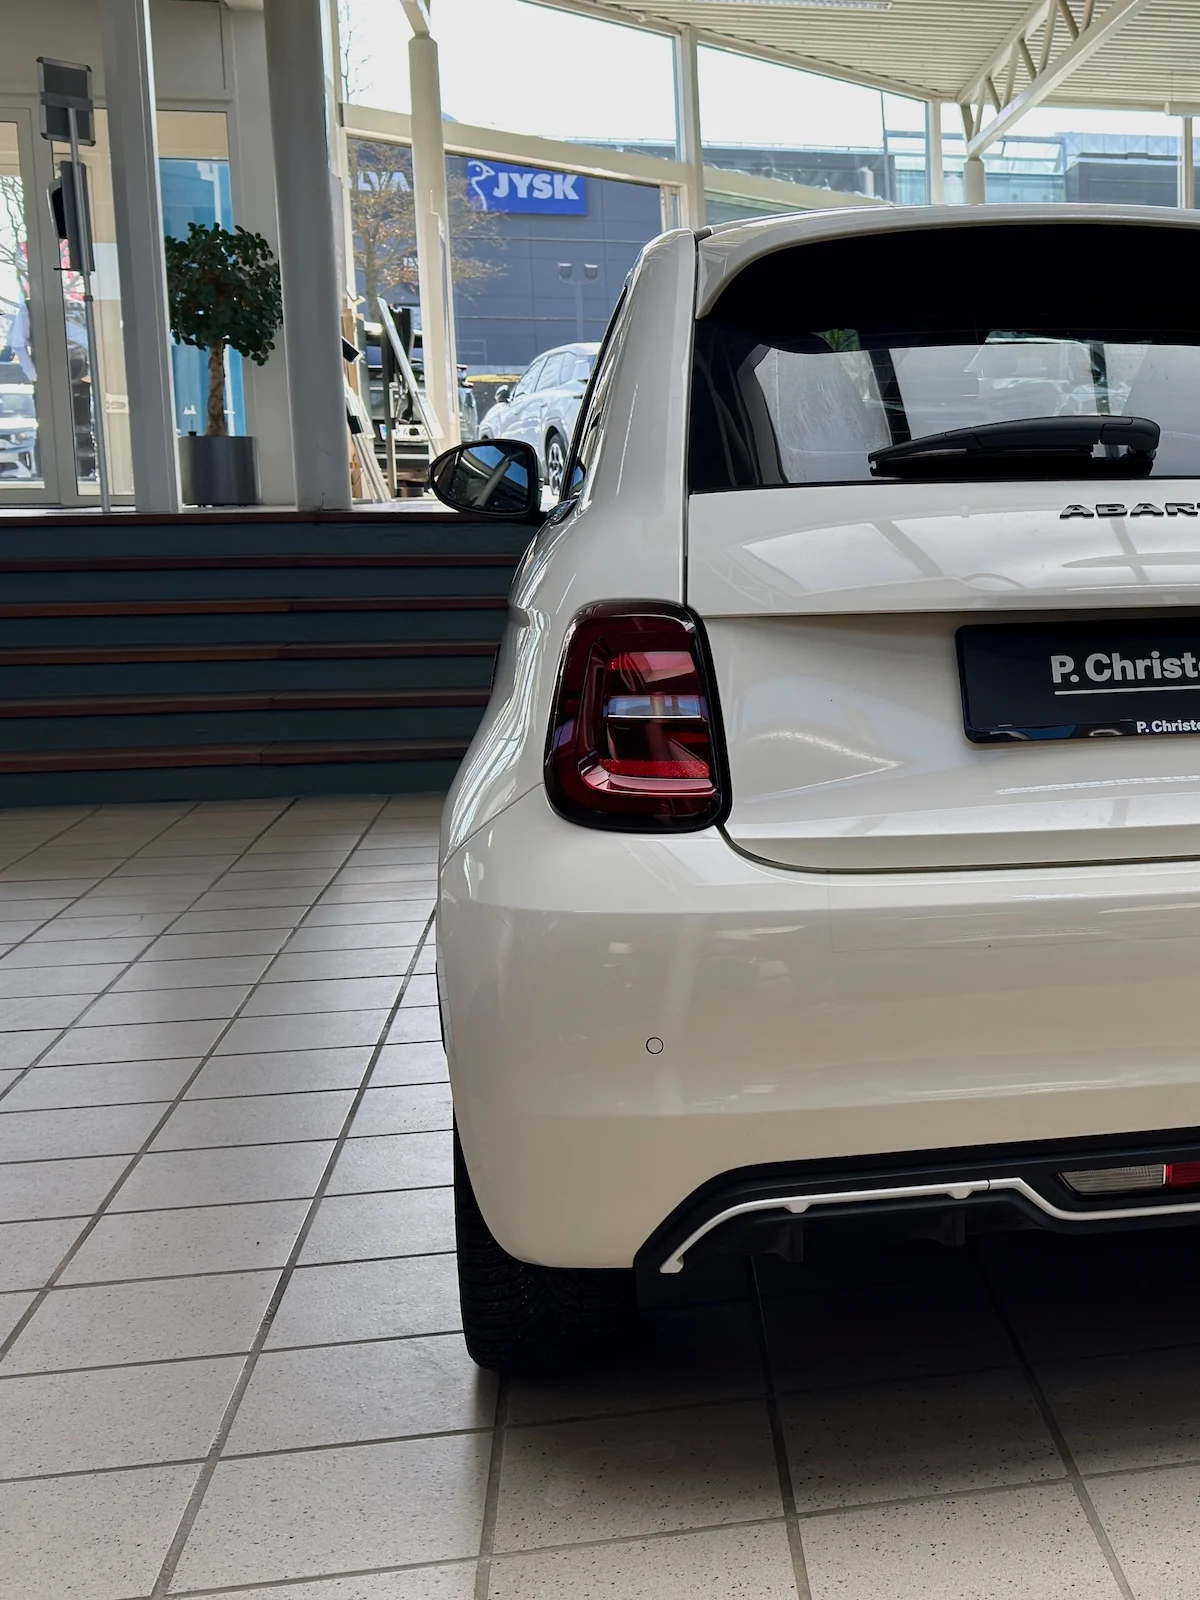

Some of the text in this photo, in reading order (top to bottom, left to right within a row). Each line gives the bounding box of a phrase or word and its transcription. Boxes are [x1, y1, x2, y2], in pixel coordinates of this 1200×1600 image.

[492, 172, 580, 200] JYSK
[1050, 655, 1080, 684] P.
[1136, 721, 1150, 733] P.
